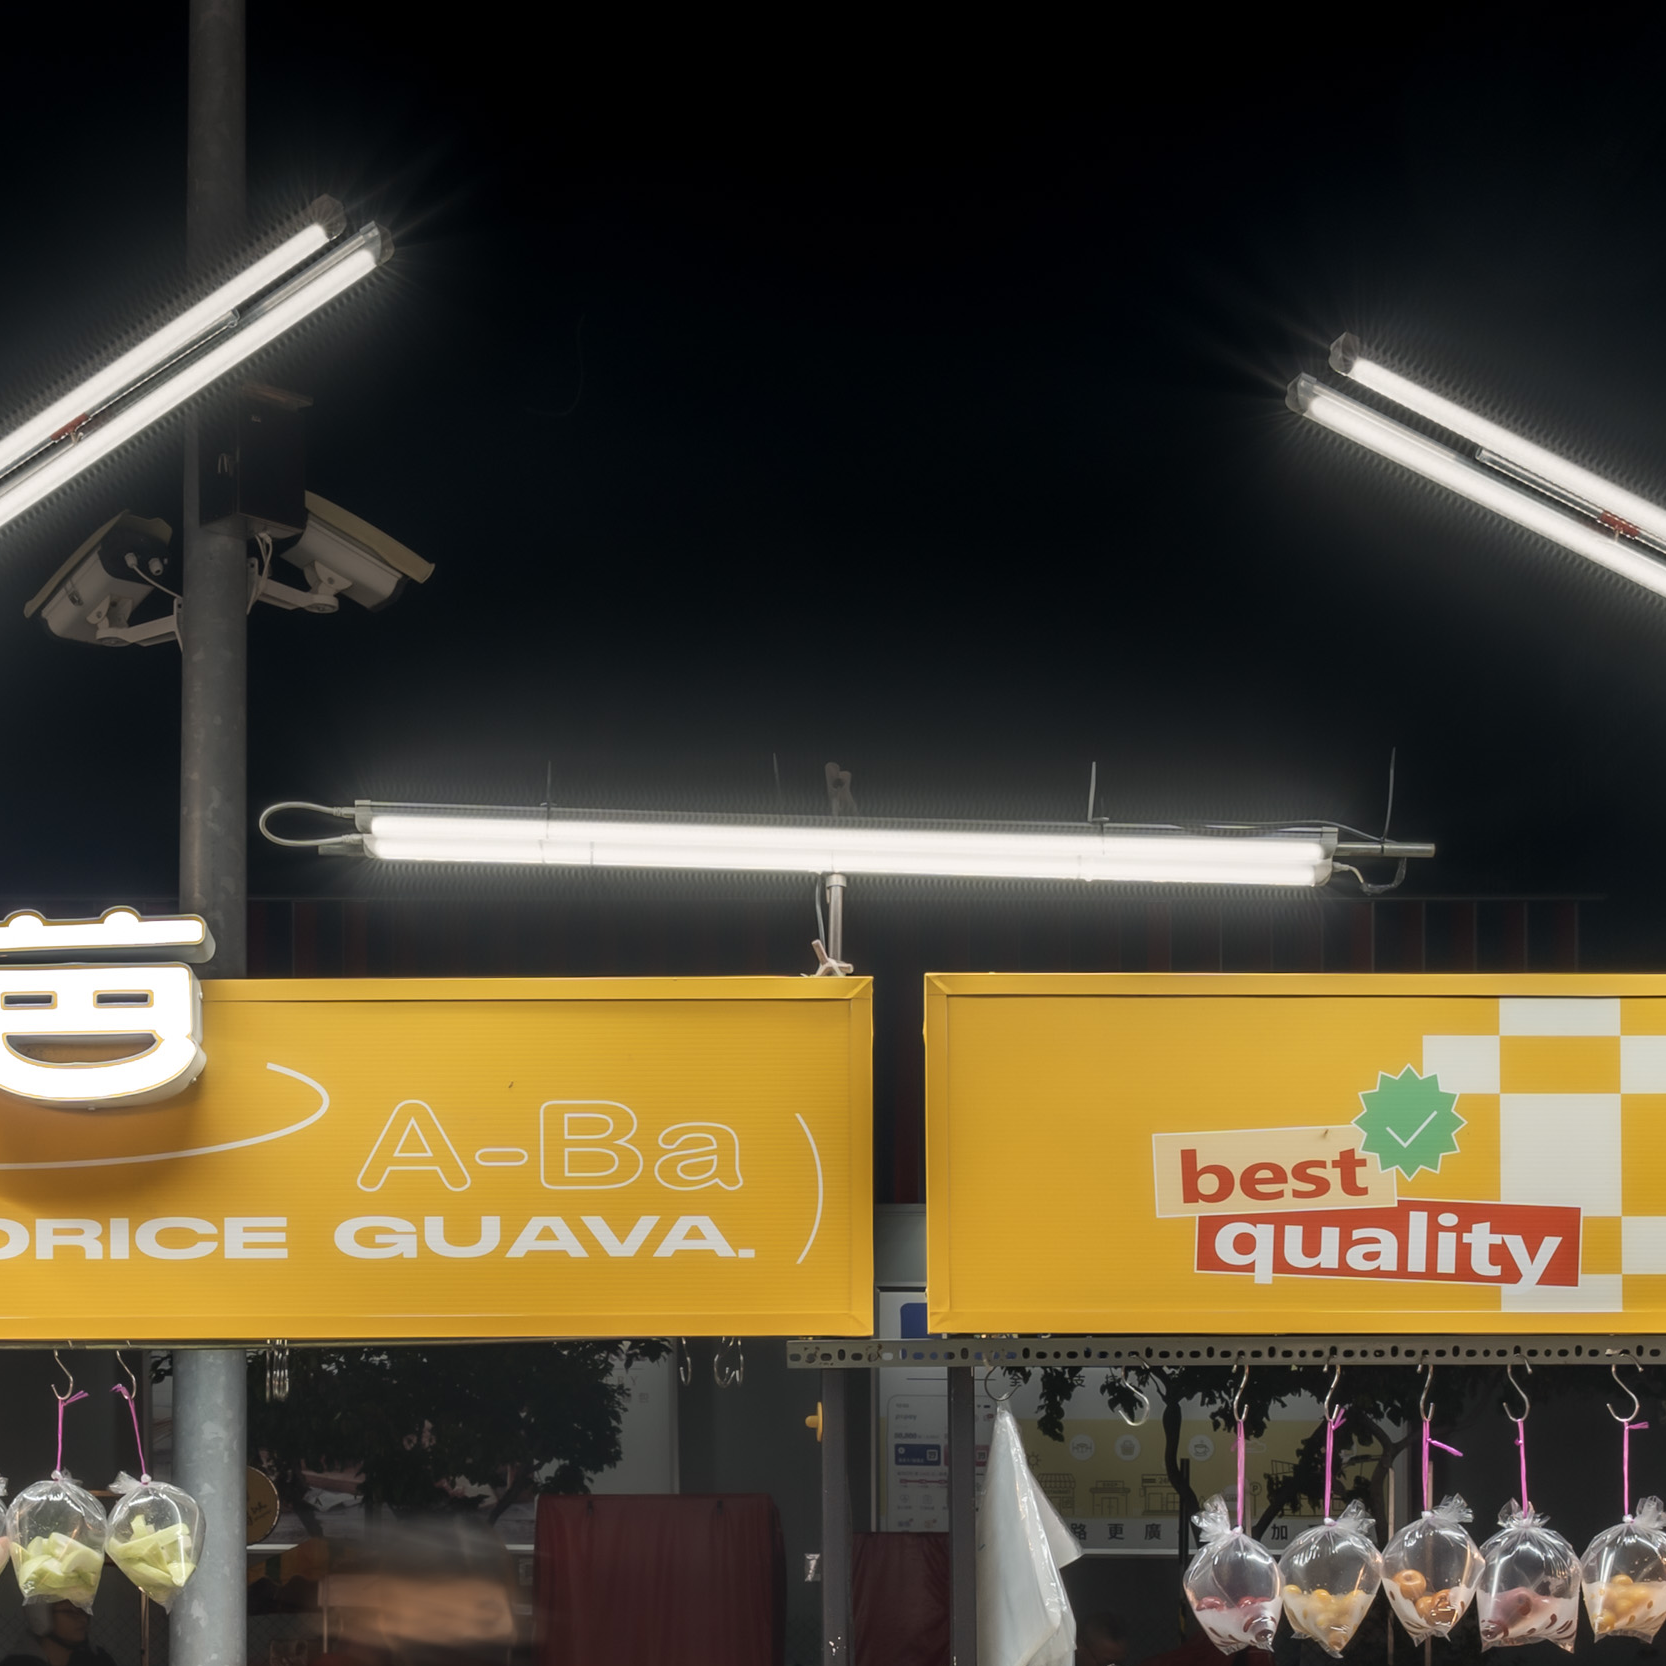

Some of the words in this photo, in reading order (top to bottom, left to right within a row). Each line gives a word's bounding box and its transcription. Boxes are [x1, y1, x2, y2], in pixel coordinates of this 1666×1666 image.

[356, 1099, 743, 1192] A-Ba
[1180, 1147, 1370, 1205] best
[334, 1215, 755, 1259] GUAVA.
[1213, 1211, 1564, 1294] quality
